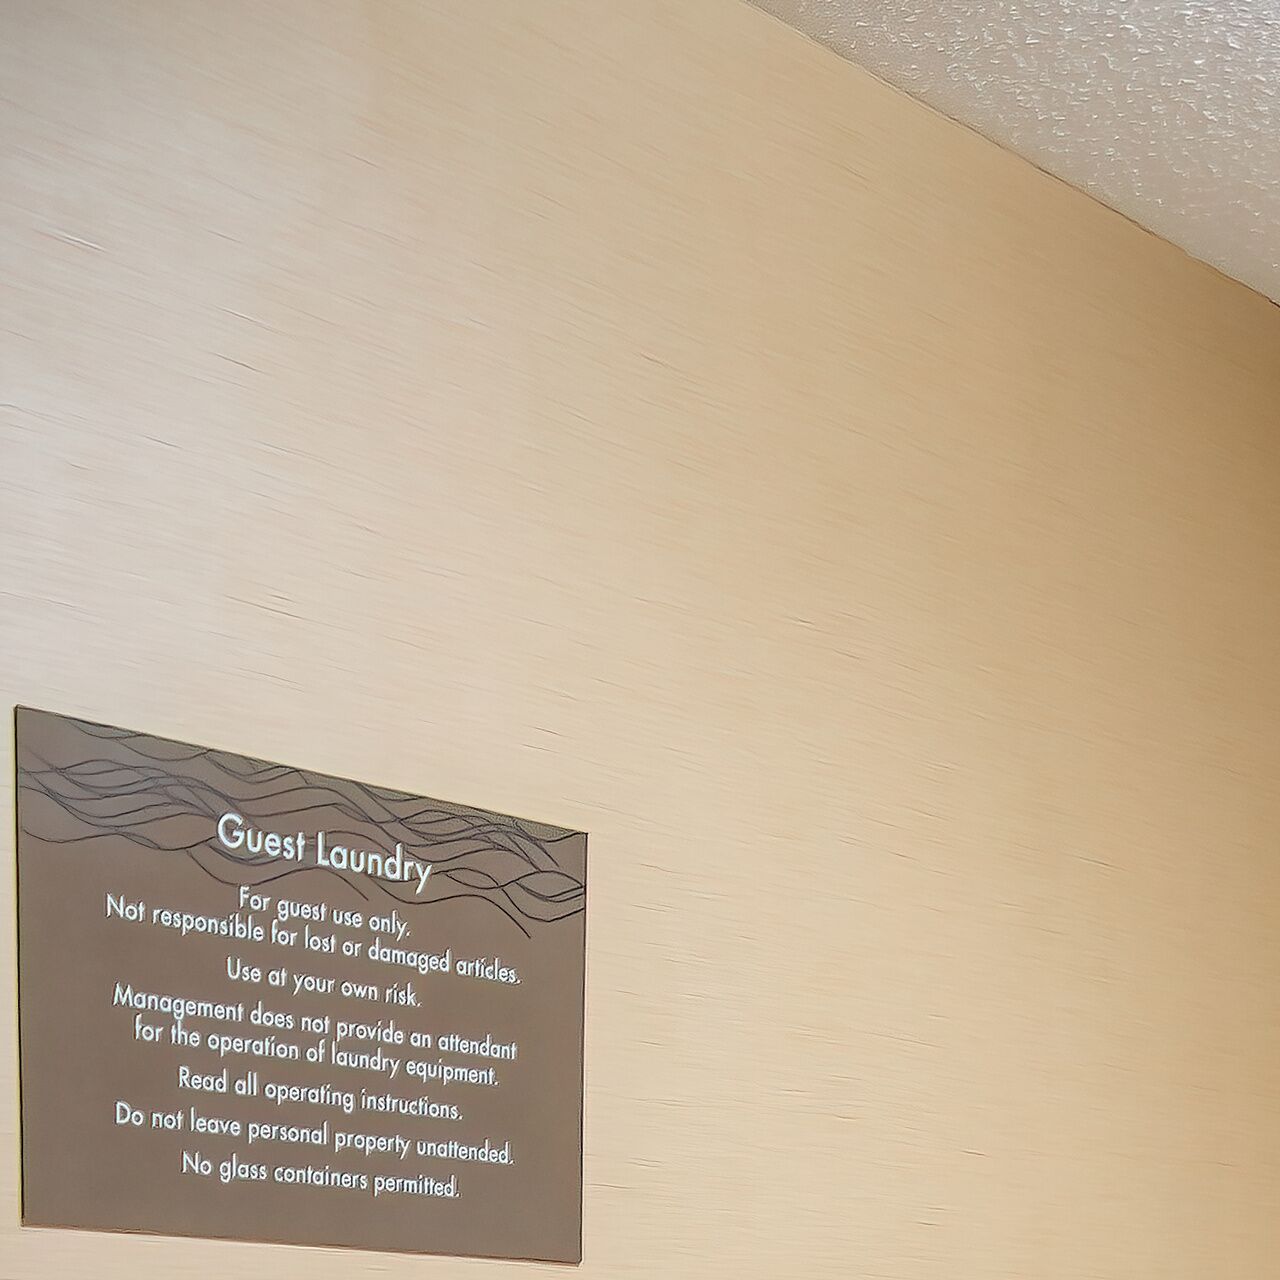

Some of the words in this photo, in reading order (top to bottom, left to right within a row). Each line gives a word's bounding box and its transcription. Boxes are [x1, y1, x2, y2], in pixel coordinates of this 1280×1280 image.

[217, 813, 305, 861] Guest
[316, 831, 432, 894] Laundry
[106, 893, 145, 921] Not
[153, 907, 264, 941] responsible
[271, 919, 297, 946] for
[305, 924, 336, 953] lost
[343, 940, 362, 956] or
[368, 938, 450, 975] damaged
[456, 958, 522, 984] articles.
[239, 886, 271, 911] For
[278, 899, 326, 921] guest
[333, 908, 363, 928] use
[369, 910, 411, 941] only.
[226, 956, 261, 982] Use
[268, 968, 287, 986] at
[293, 974, 334, 996] your
[341, 984, 378, 1000] own
[386, 982, 422, 1007] risk.
[113, 982, 243, 1021] Management
[250, 1000, 294, 1029] does
[301, 1016, 329, 1034] not
[337, 1020, 403, 1044] provide
[410, 1032, 431, 1048] an
[438, 1034, 518, 1060] attendant
[134, 1013, 163, 1041] for
[171, 1021, 200, 1046] the
[207, 1035, 299, 1060] operation
[306, 1039, 325, 1062] of
[332, 1041, 400, 1078] laundry
[406, 1059, 499, 1085] equipment.
[179, 1066, 227, 1093] Read
[235, 1071, 257, 1096] all
[264, 1084, 354, 1113] operating
[361, 1089, 463, 1120] instructions.
[115, 1101, 143, 1126] Do
[152, 1110, 184, 1129] not
[191, 1106, 241, 1136] leave
[248, 1121, 328, 1144] personal
[335, 1132, 410, 1159] property
[417, 1139, 514, 1164] unattended.
[182, 1151, 211, 1175] No
[219, 1153, 267, 1183] glass
[274, 1166, 368, 1189] containers
[374, 1175, 461, 1197] permitted.
